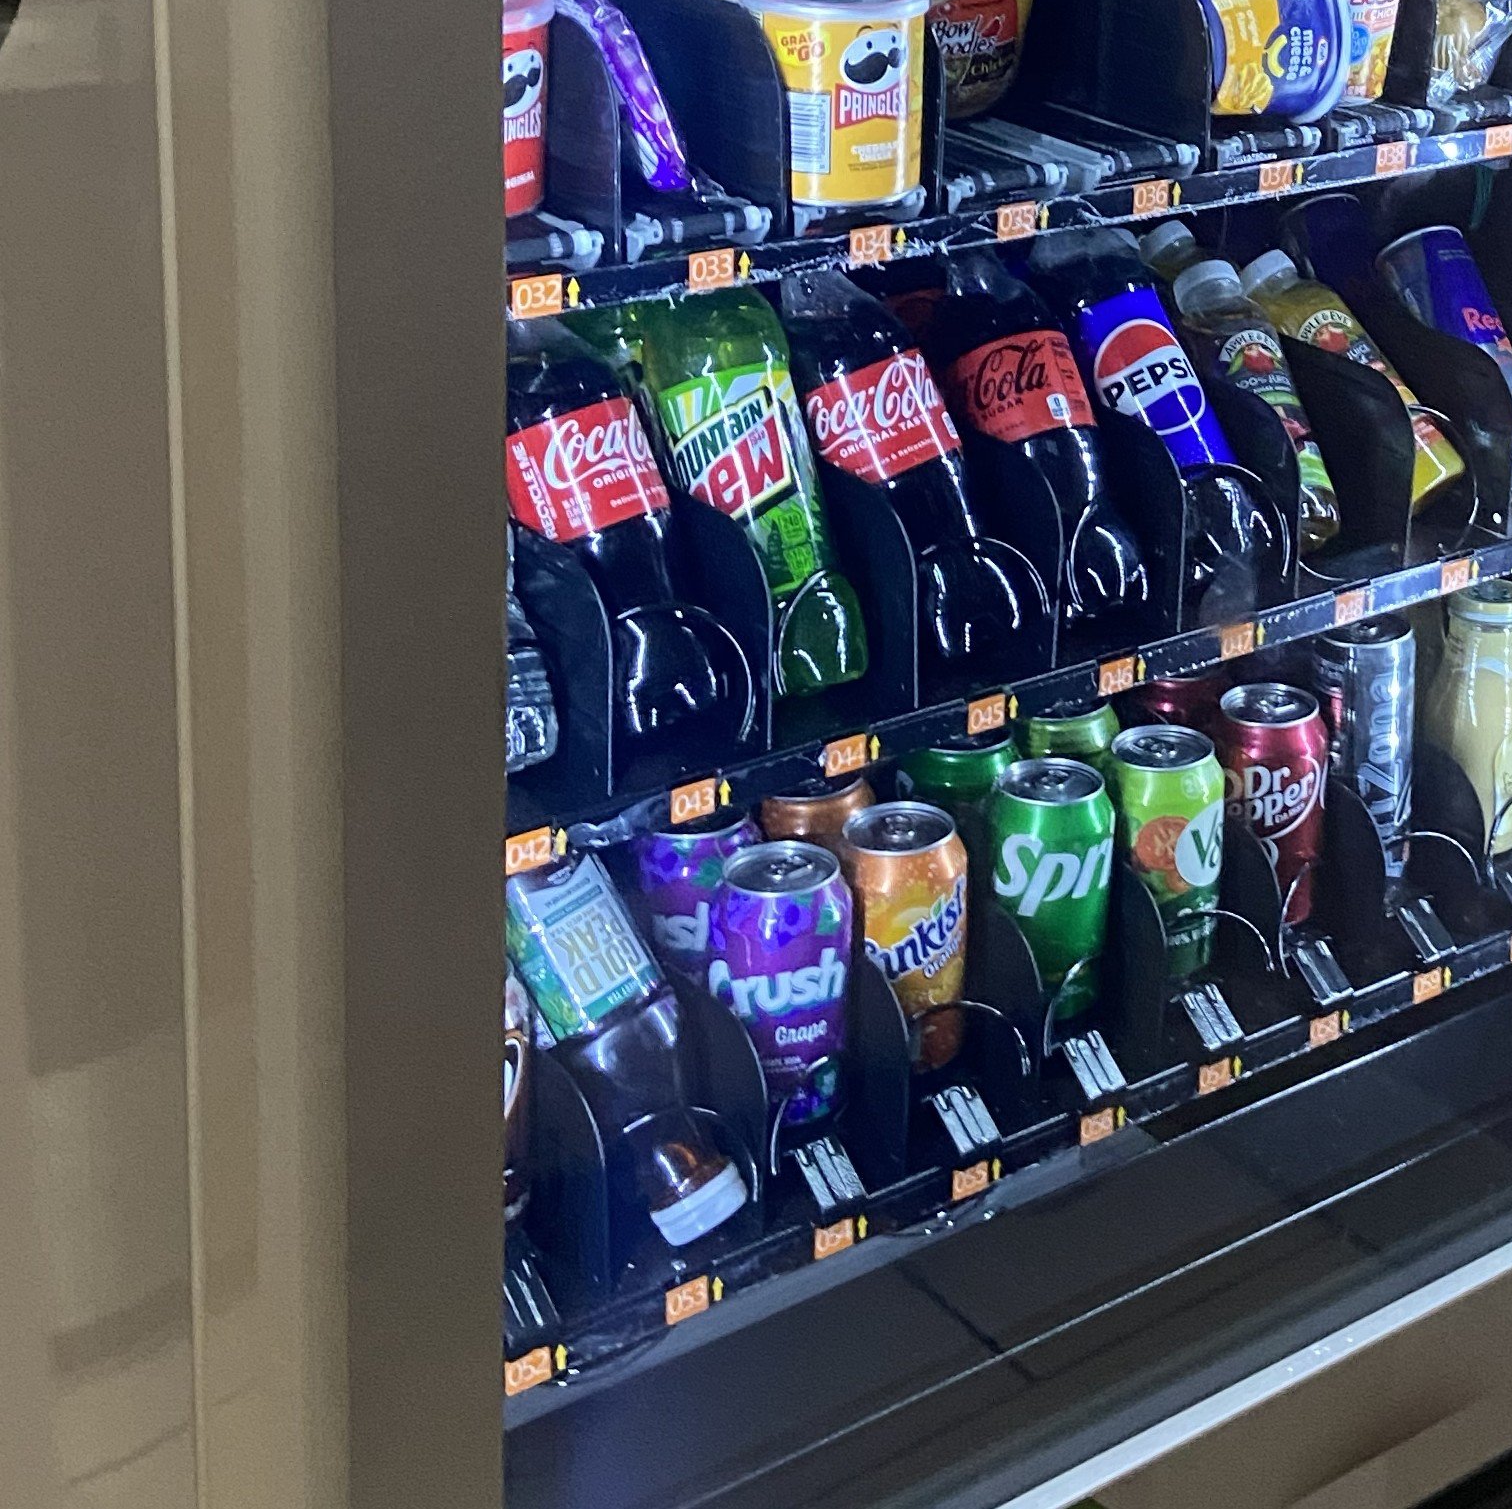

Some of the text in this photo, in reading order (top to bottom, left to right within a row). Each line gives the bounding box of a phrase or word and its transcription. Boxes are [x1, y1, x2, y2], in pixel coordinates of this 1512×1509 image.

[503, 102, 542, 145] INGLES
[1486, 130, 1512, 150] 039
[1377, 147, 1405, 168] 038
[1261, 165, 1291, 186] 037
[1134, 186, 1168, 208] 036
[999, 207, 1034, 232] 035
[852, 234, 889, 259] 034
[691, 256, 733, 284] 033
[515, 281, 561, 309] 032
[1101, 357, 1195, 410] PEPSI
[1100, 663, 1133, 690] 046
[969, 702, 1004, 730] 045
[827, 742, 866, 773] 044
[1245, 766, 1292, 800] Dr
[673, 787, 714, 818] 043
[506, 836, 550, 870] 042
[774, 1019, 829, 1047] Grape
